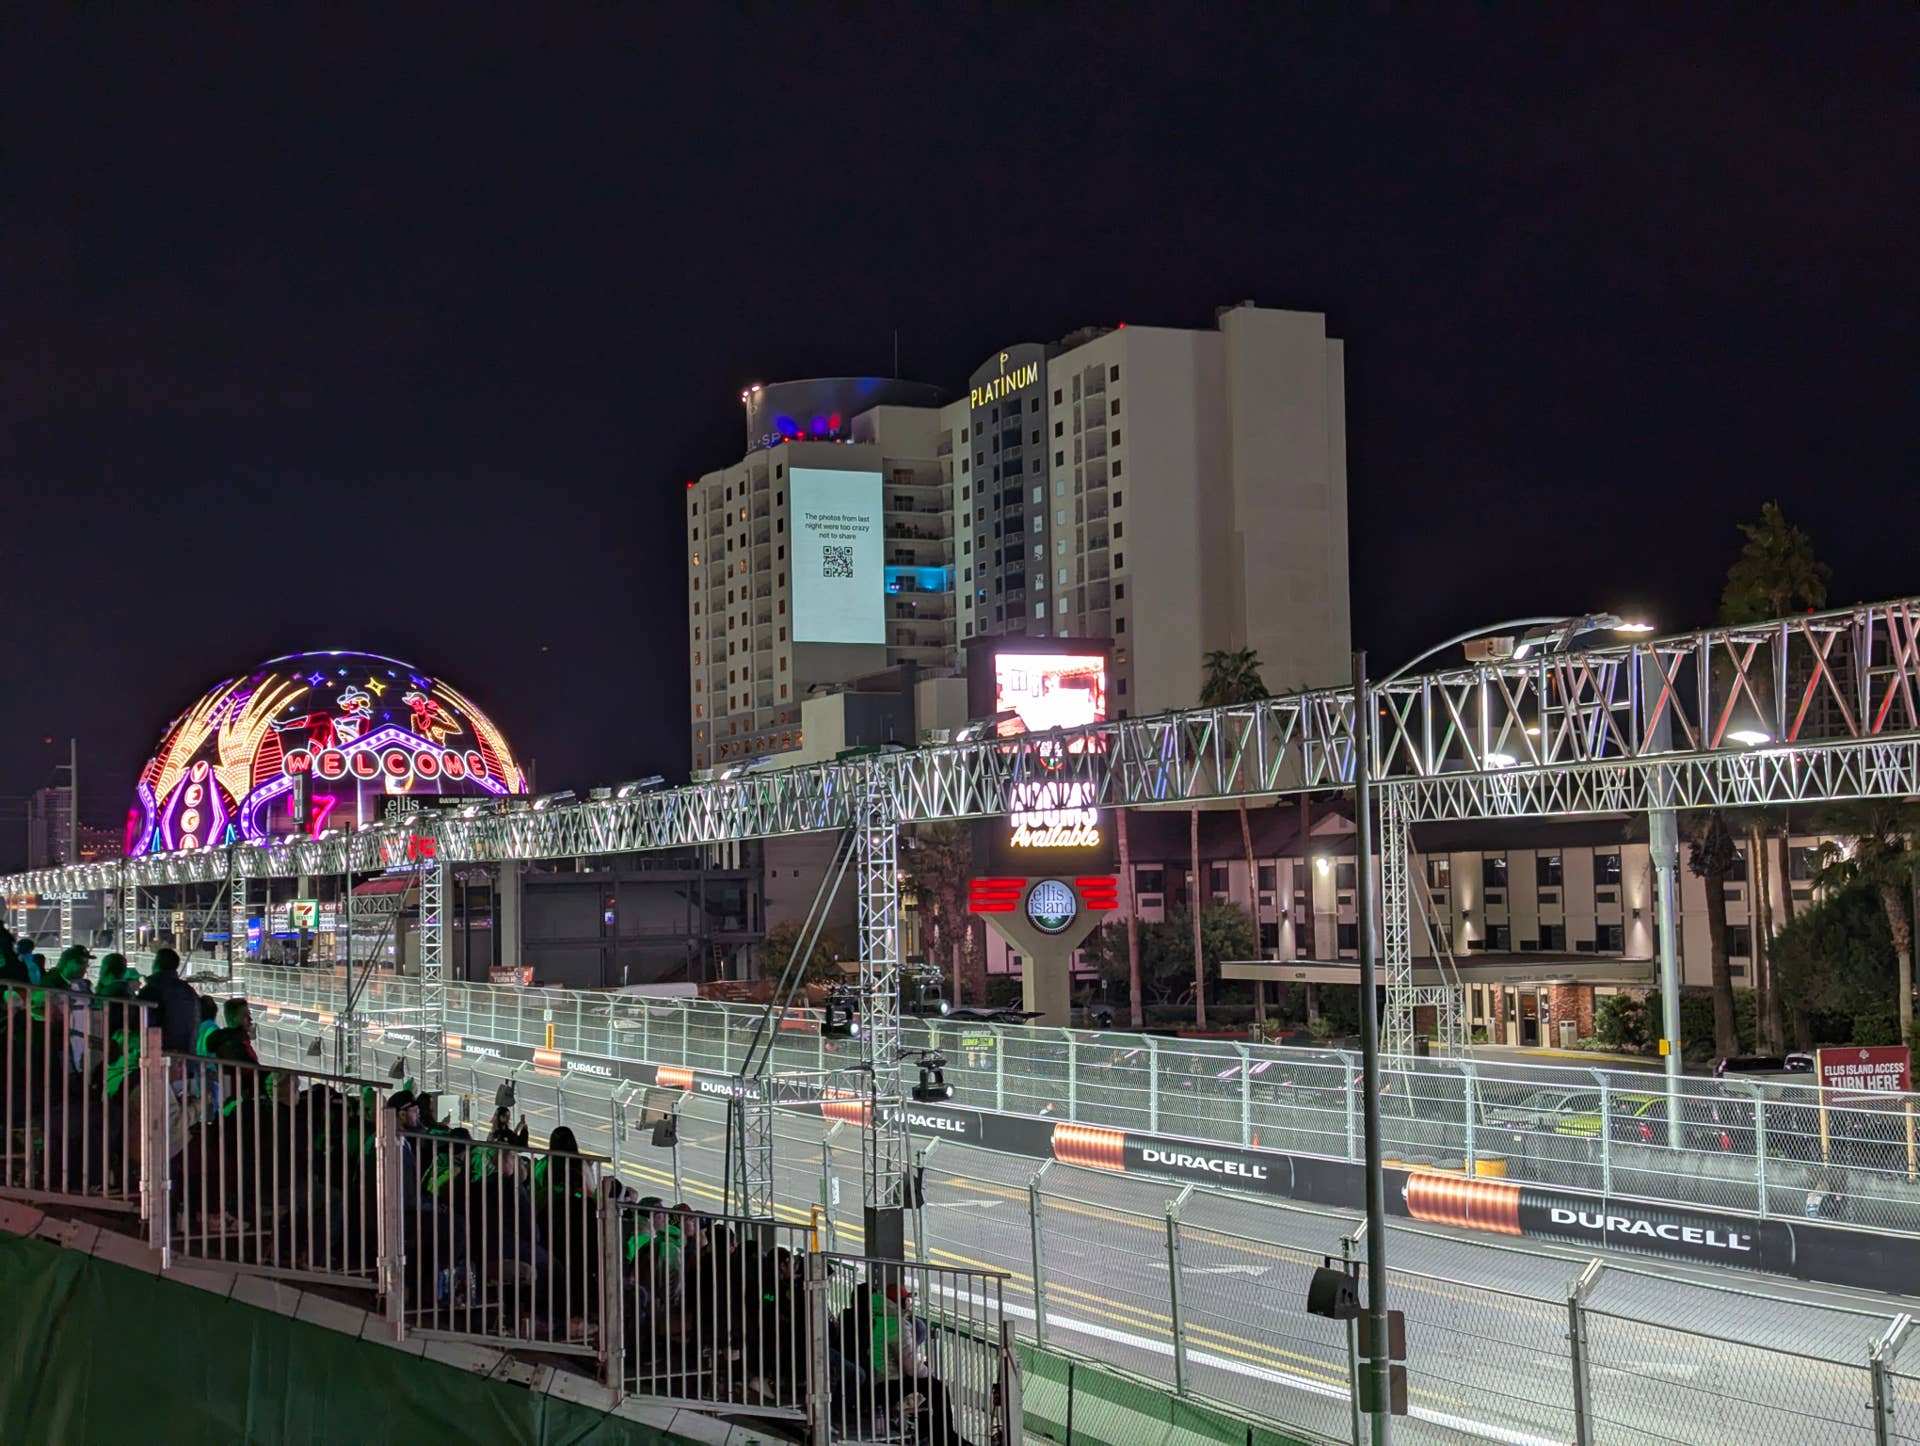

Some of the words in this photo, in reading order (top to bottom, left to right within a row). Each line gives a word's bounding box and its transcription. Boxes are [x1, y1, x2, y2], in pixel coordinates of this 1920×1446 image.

[971, 361, 1038, 409] PLATINUM
[819, 514, 841, 522] photos
[805, 523, 822, 531] night
[287, 753, 485, 777] WELCOME
[1010, 823, 1100, 847] Available
[1033, 884, 1064, 901] ellis
[1030, 897, 1073, 914] island
[465, 1044, 500, 1057] DURACELL
[567, 1061, 612, 1077] DURACELL
[1824, 1065, 1846, 1076] ELLIS
[1846, 1064, 1873, 1075] ISLAND
[1874, 1062, 1905, 1074] ACCESS
[1830, 1075, 1864, 1091] TURN
[1867, 1074, 1901, 1091] HERE
[1143, 1149, 1267, 1180] DURACELL
[1551, 1208, 1751, 1251] DURACELL
